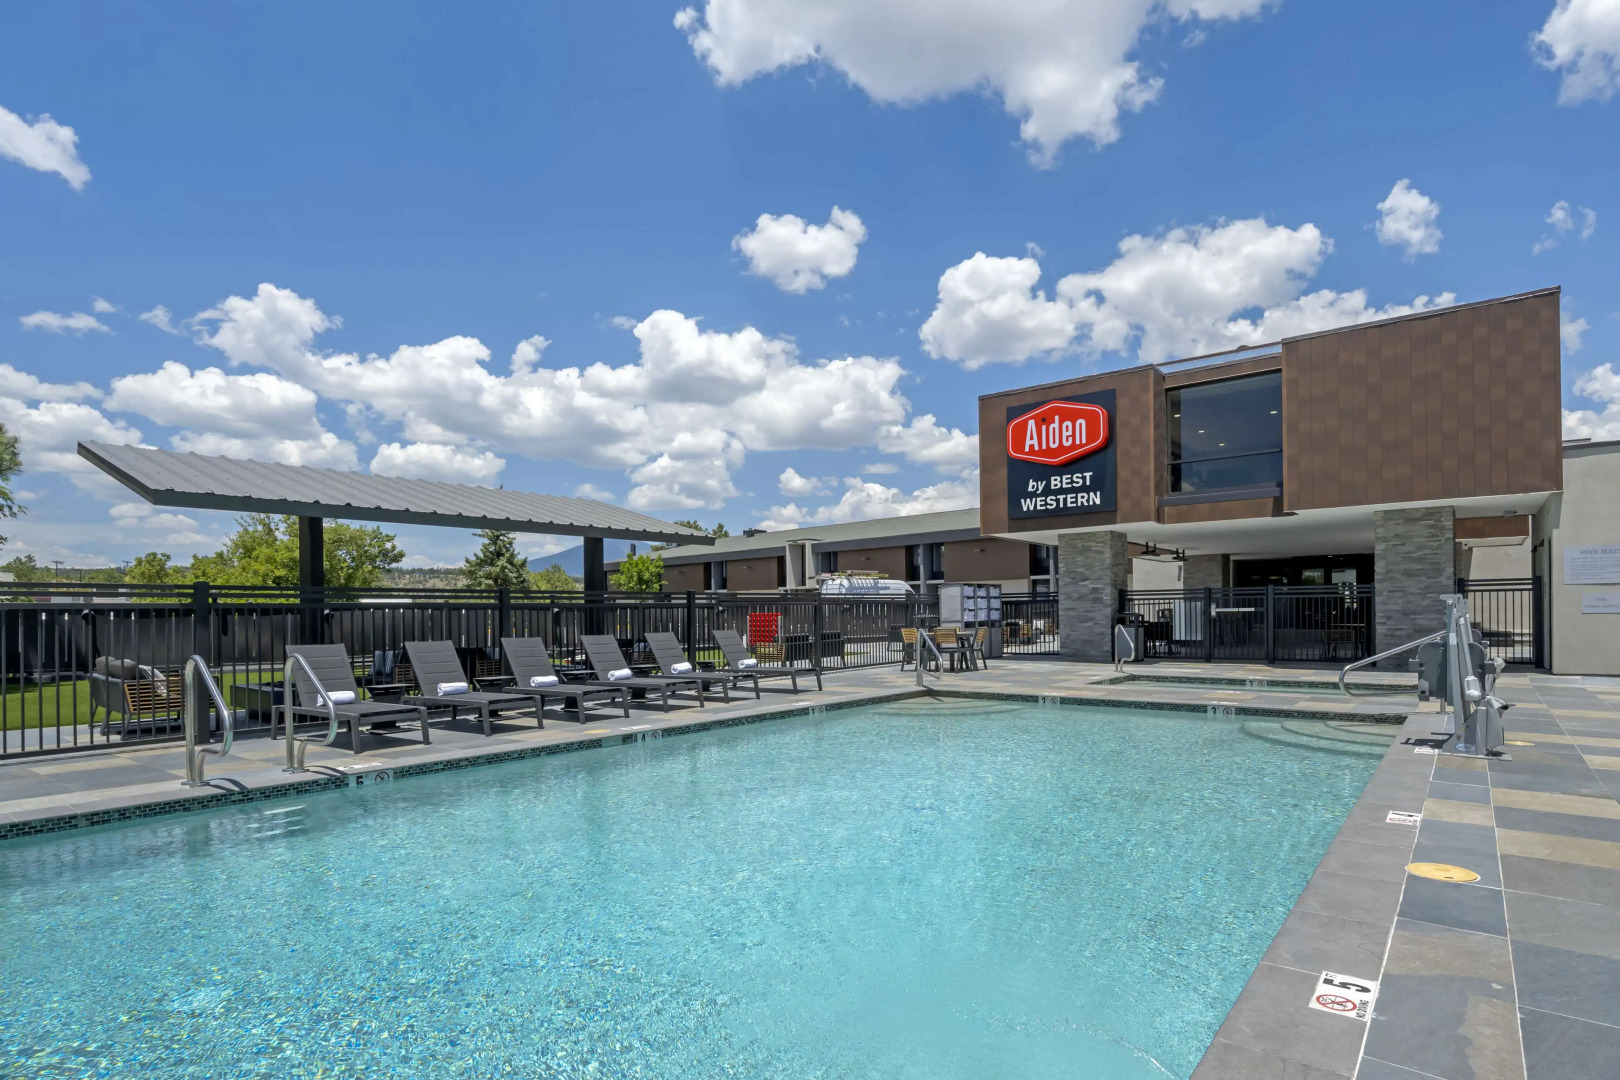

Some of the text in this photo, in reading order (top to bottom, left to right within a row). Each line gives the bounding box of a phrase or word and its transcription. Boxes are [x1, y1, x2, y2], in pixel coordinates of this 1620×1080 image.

[1024, 415, 1087, 453] Aiden
[1027, 471, 1093, 494] by BEST
[1020, 491, 1101, 512] WESTERN
